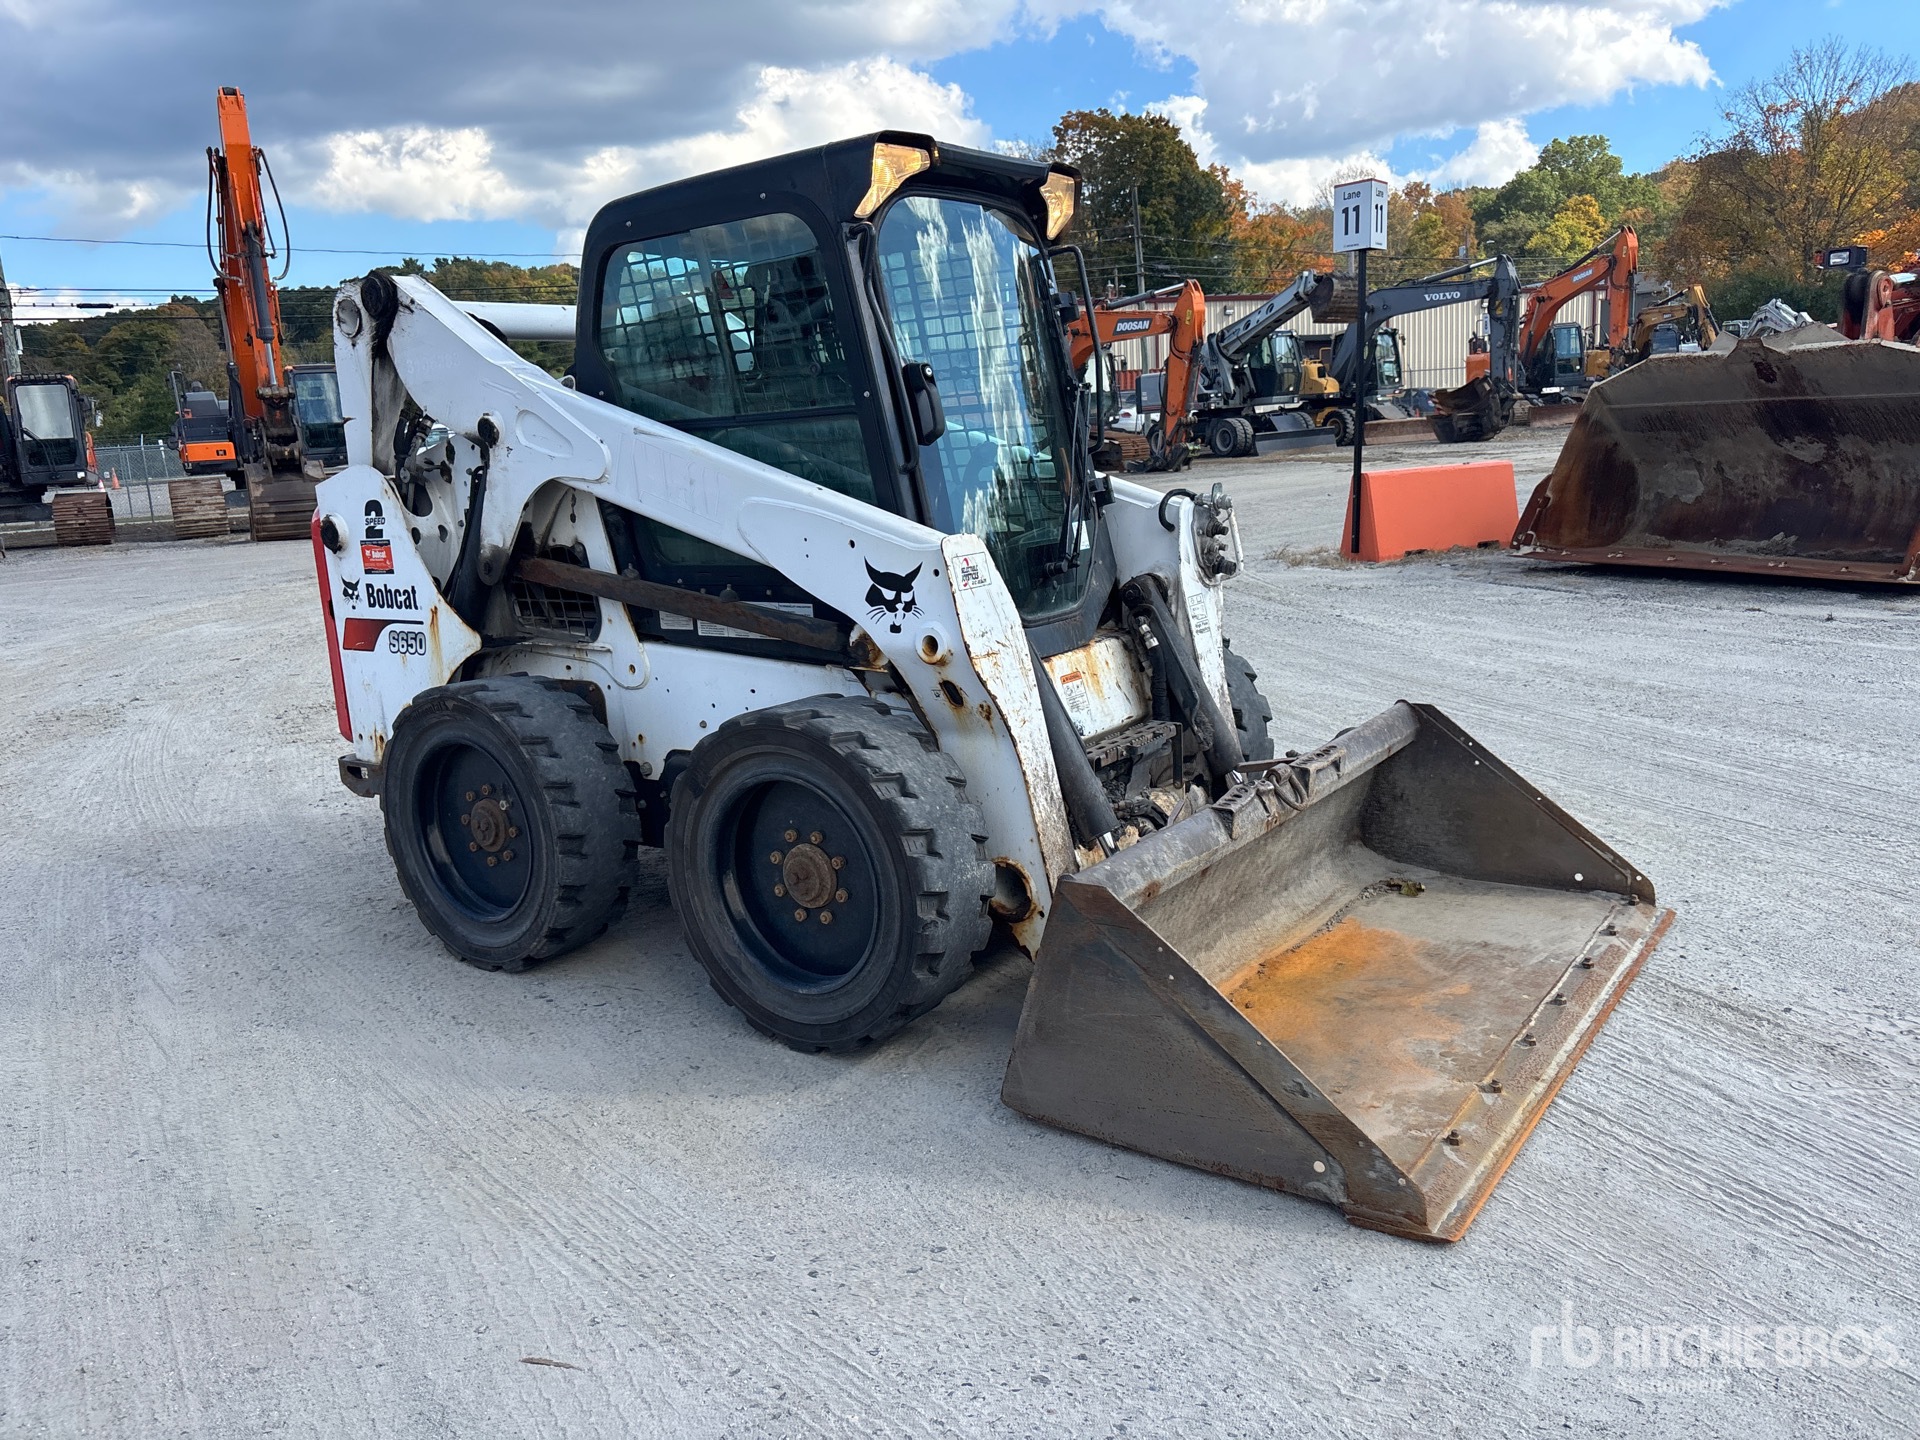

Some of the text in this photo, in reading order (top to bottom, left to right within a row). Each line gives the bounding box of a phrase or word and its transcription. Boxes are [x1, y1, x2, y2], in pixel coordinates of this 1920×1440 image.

[1343, 190, 1361, 201] Lane
[1376, 188, 1384, 198] Lane
[1342, 204, 1360, 236] 11
[1375, 203, 1383, 233] 11
[1424, 290, 1461, 302] VOLVO
[1116, 320, 1150, 332] DOOSAN
[365, 517, 386, 526] SPEED
[365, 583, 419, 610] Bobcat
[389, 630, 427, 656] S650
